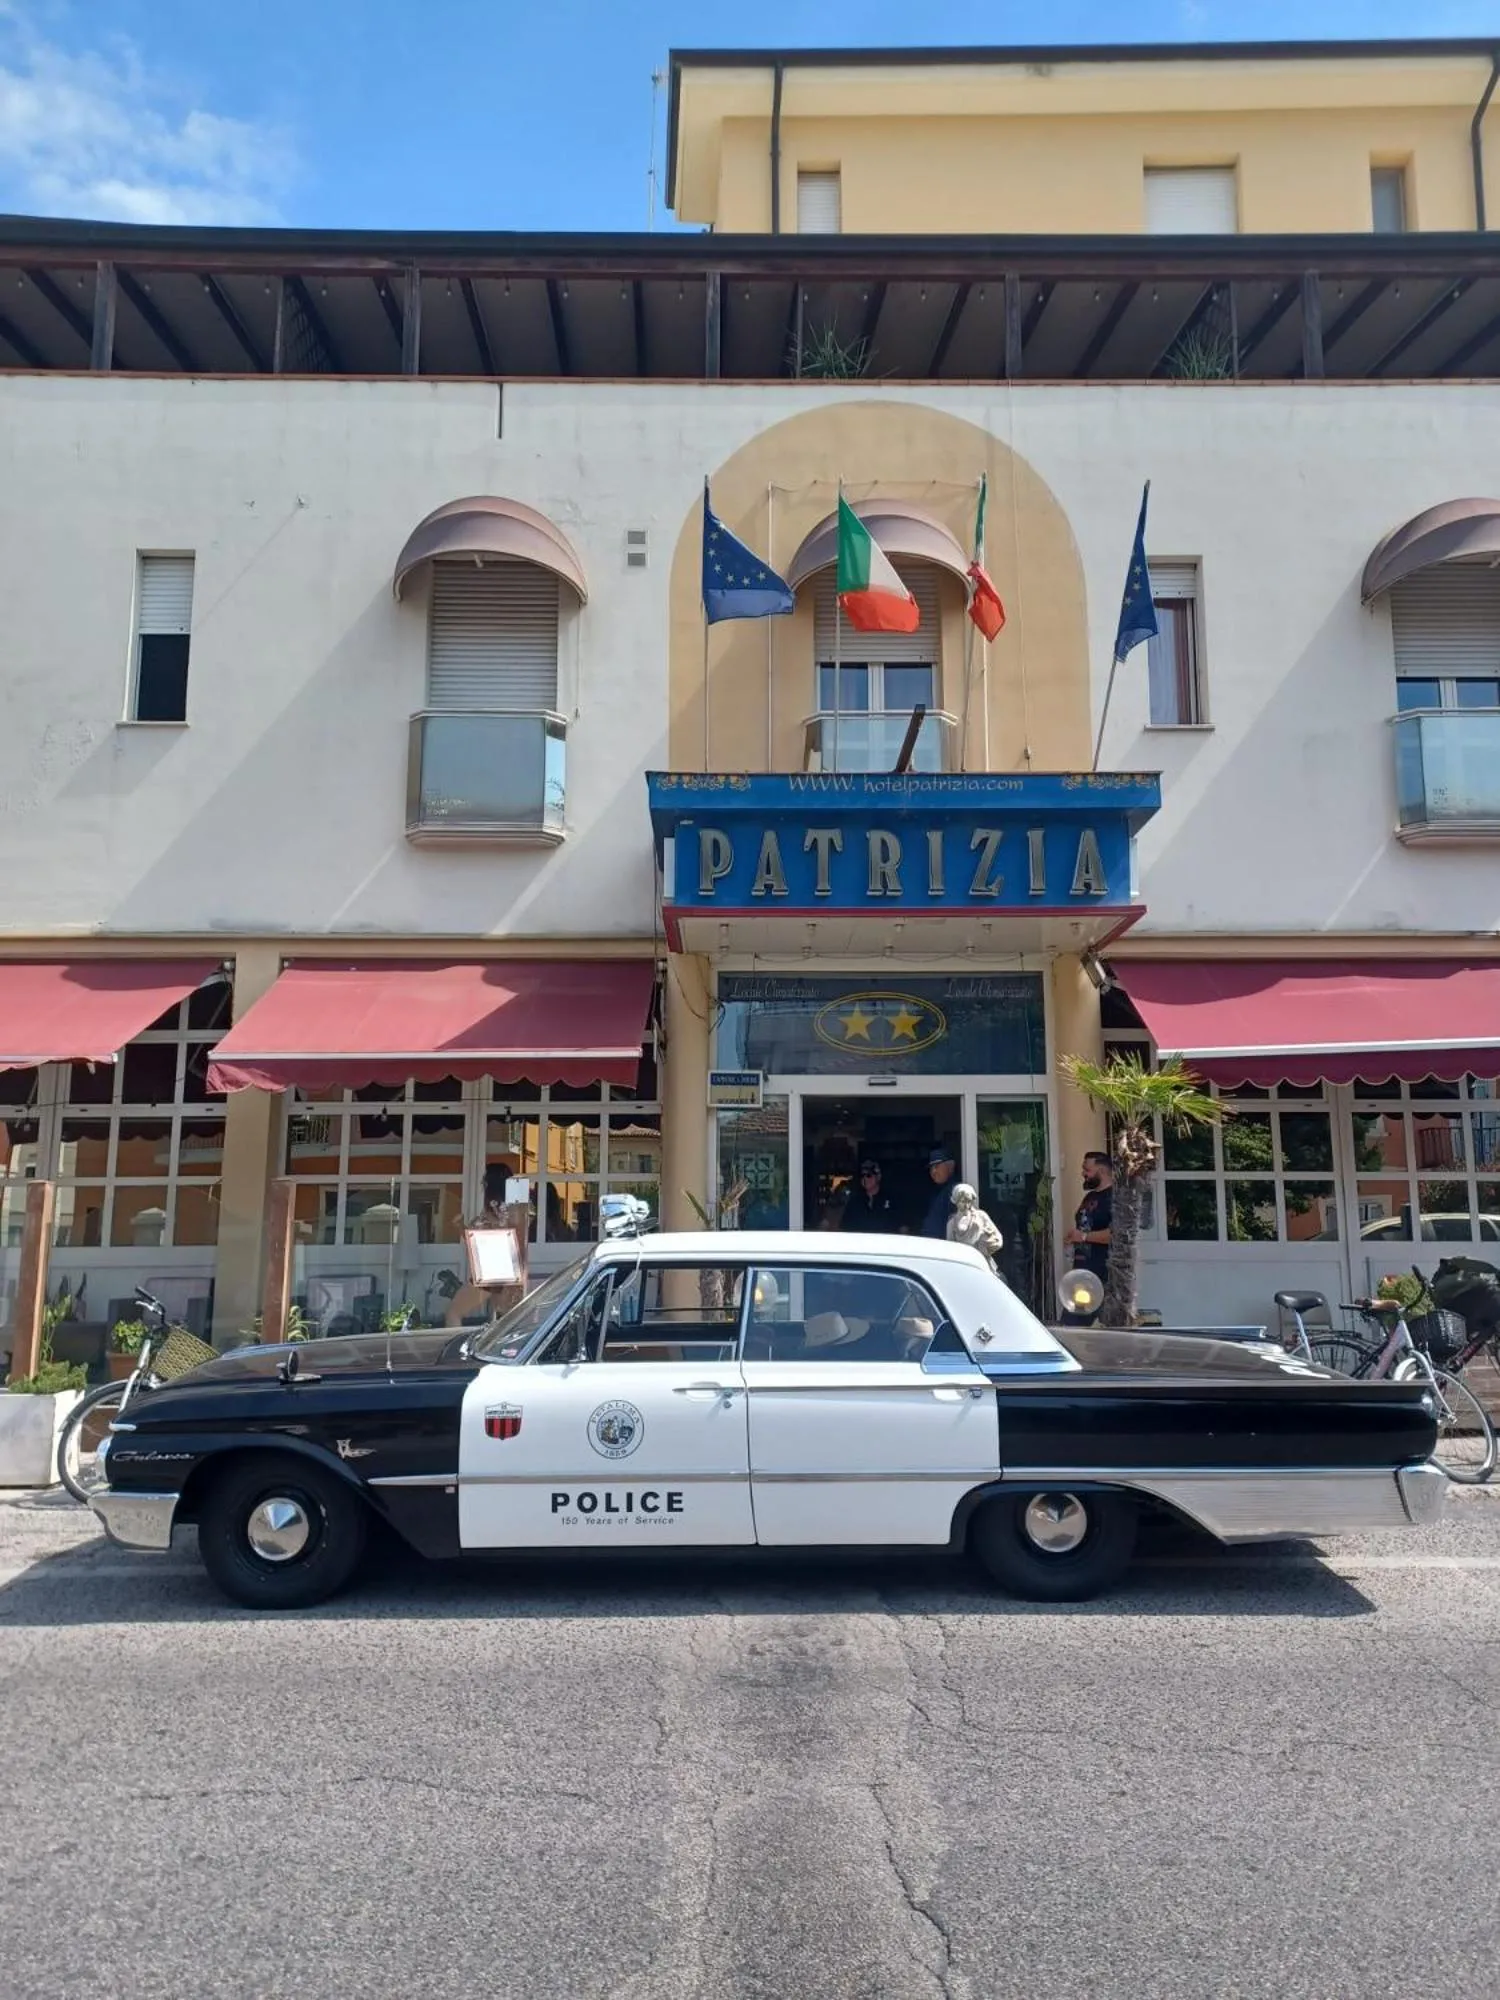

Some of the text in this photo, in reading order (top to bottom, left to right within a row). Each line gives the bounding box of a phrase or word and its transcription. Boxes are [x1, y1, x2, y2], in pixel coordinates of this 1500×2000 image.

[698, 828, 1109, 897] PATRIZIA
[591, 1402, 640, 1424] PETALUMA
[551, 1491, 684, 1513] POLICE
[562, 1516, 674, 1525] 150 Years of Service
